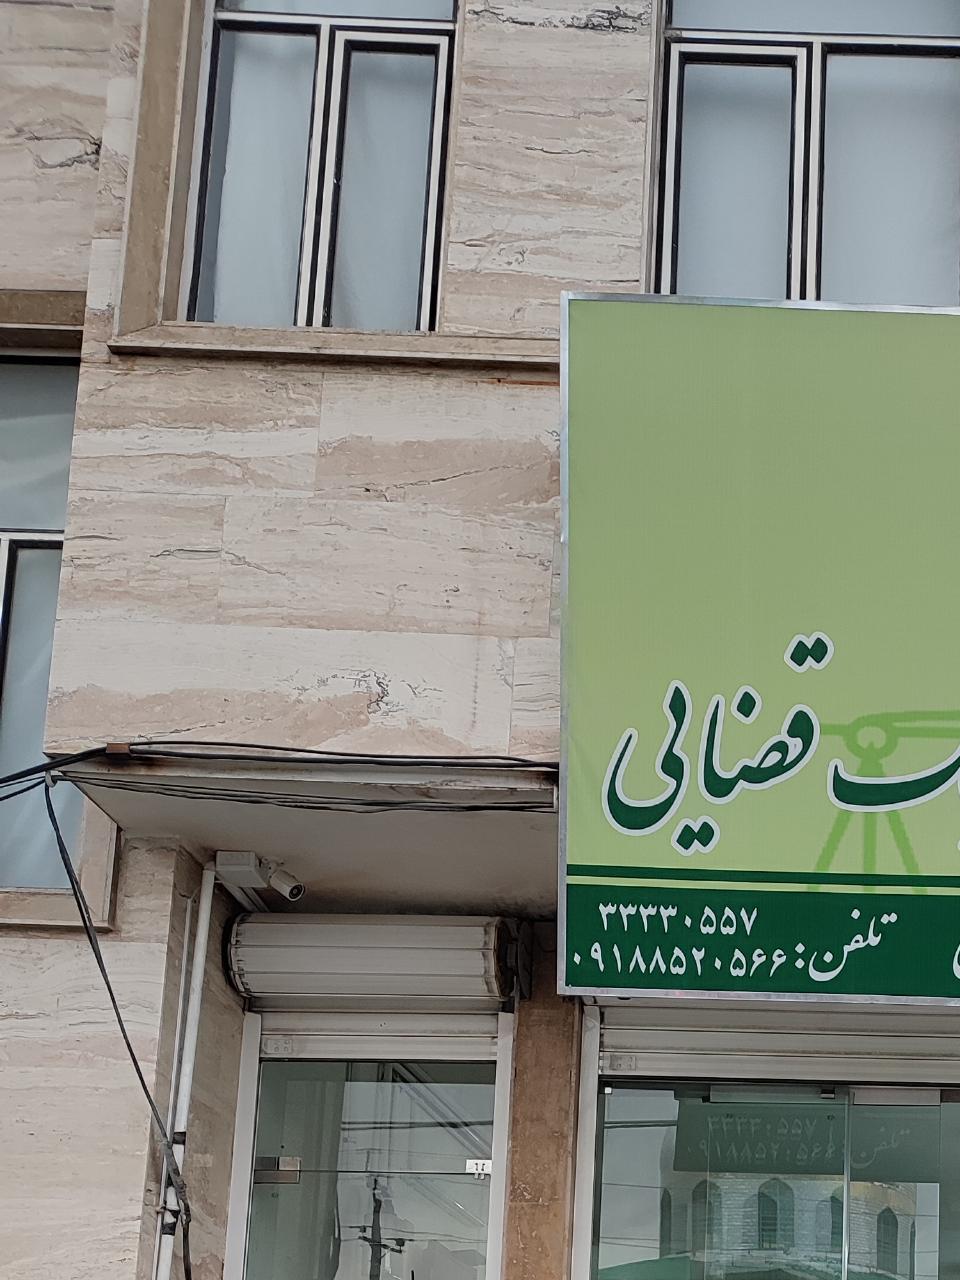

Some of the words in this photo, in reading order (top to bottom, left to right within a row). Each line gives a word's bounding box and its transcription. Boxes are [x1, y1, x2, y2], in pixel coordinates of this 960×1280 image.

[606, 631, 834, 858] قضایی
[598, 901, 759, 937] ۳۳۳۳۰۵۵۷
[573, 940, 788, 978] ۰۹۱۸۸۵۲۰۵۶۶
